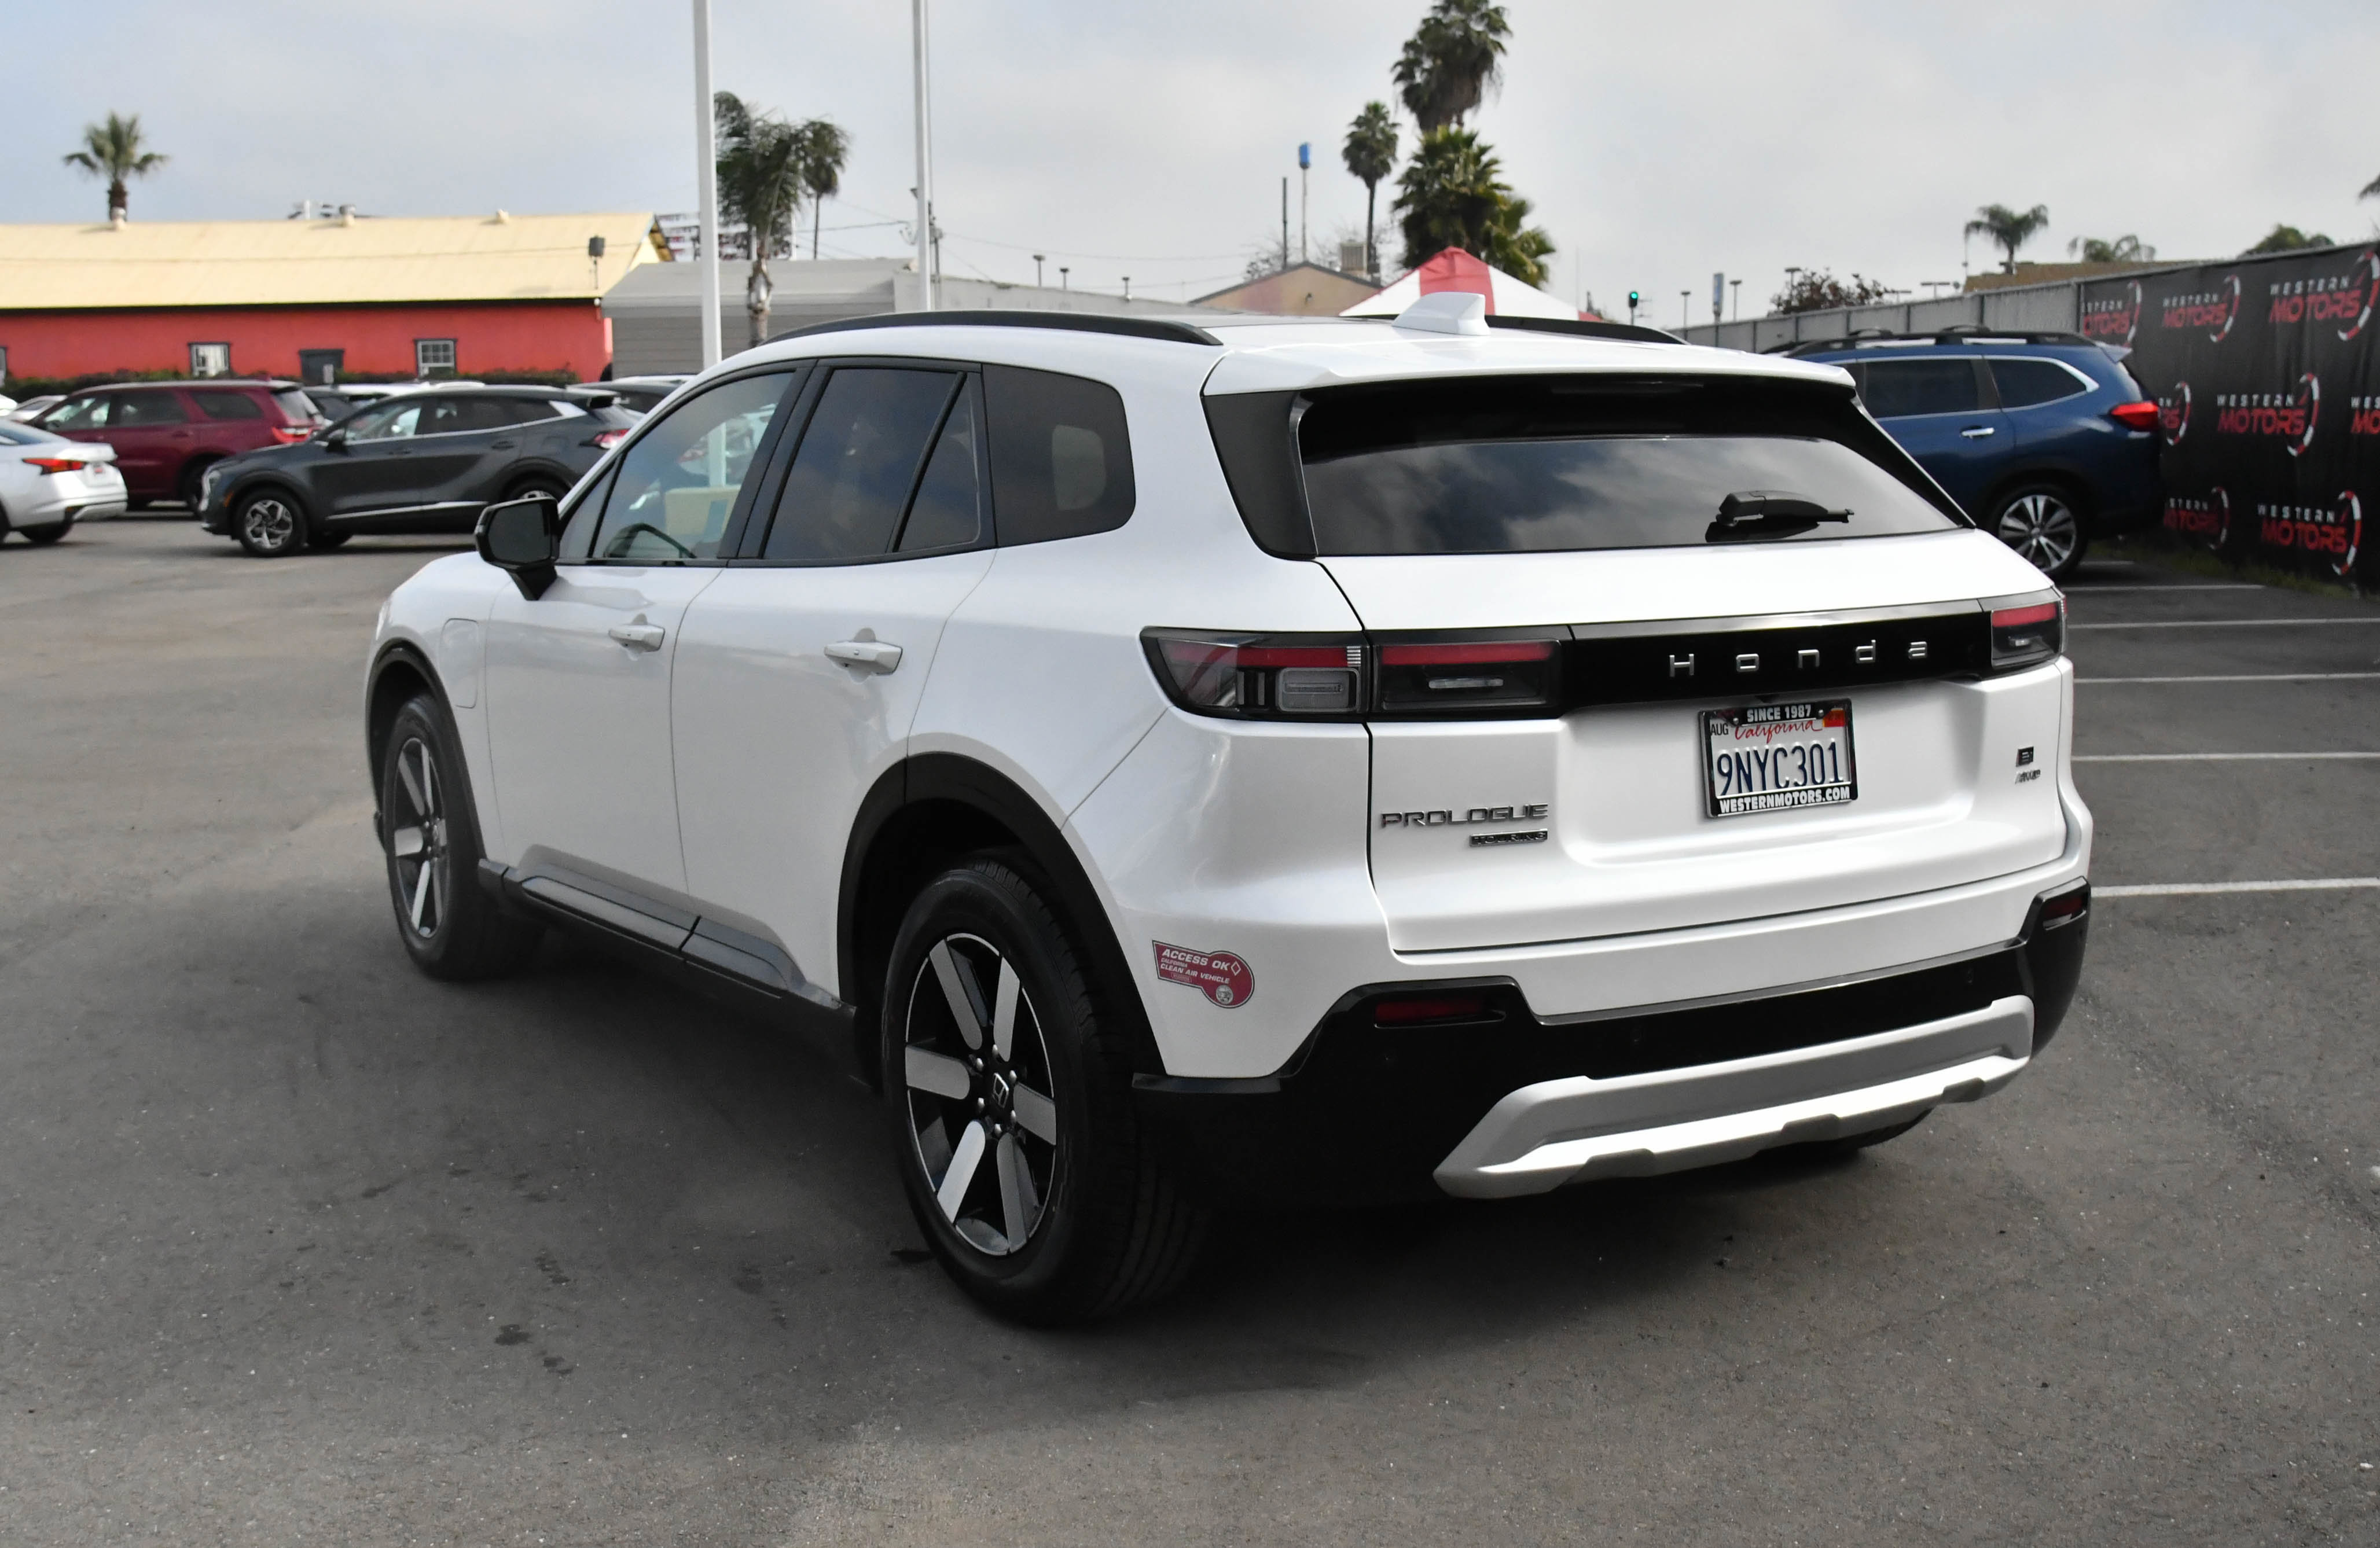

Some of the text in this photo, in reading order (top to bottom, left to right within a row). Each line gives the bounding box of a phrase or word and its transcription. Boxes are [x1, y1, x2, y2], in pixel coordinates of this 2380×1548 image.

[2270, 275, 2350, 295] WESTERN
[2162, 293, 2219, 307] WESTERN
[2269, 290, 2361, 323] MOTORS
[2162, 303, 2227, 328] MOTORS
[2217, 394, 2294, 407] WESTERN
[2218, 407, 2306, 435] MOTORS
[2258, 504, 2335, 523] WESTERN
[2261, 517, 2347, 553] MOTORS
[1747, 707, 1780, 723] SINCE
[1785, 704, 1811, 719] 1987
[1710, 723, 1729, 736] AUG
[1735, 719, 1823, 744] California
[1717, 740, 1844, 796] 9NYC301
[1719, 786, 1850, 814] WESTERNMOTORS.COM
[1381, 803, 1548, 828] PROLOGUE
[1162, 948, 1230, 971] ACCESS OK
[1160, 963, 1184, 973] CLEAN
[1185, 969, 1198, 977] AIR
[1200, 972, 1230, 984] VEHICLE
